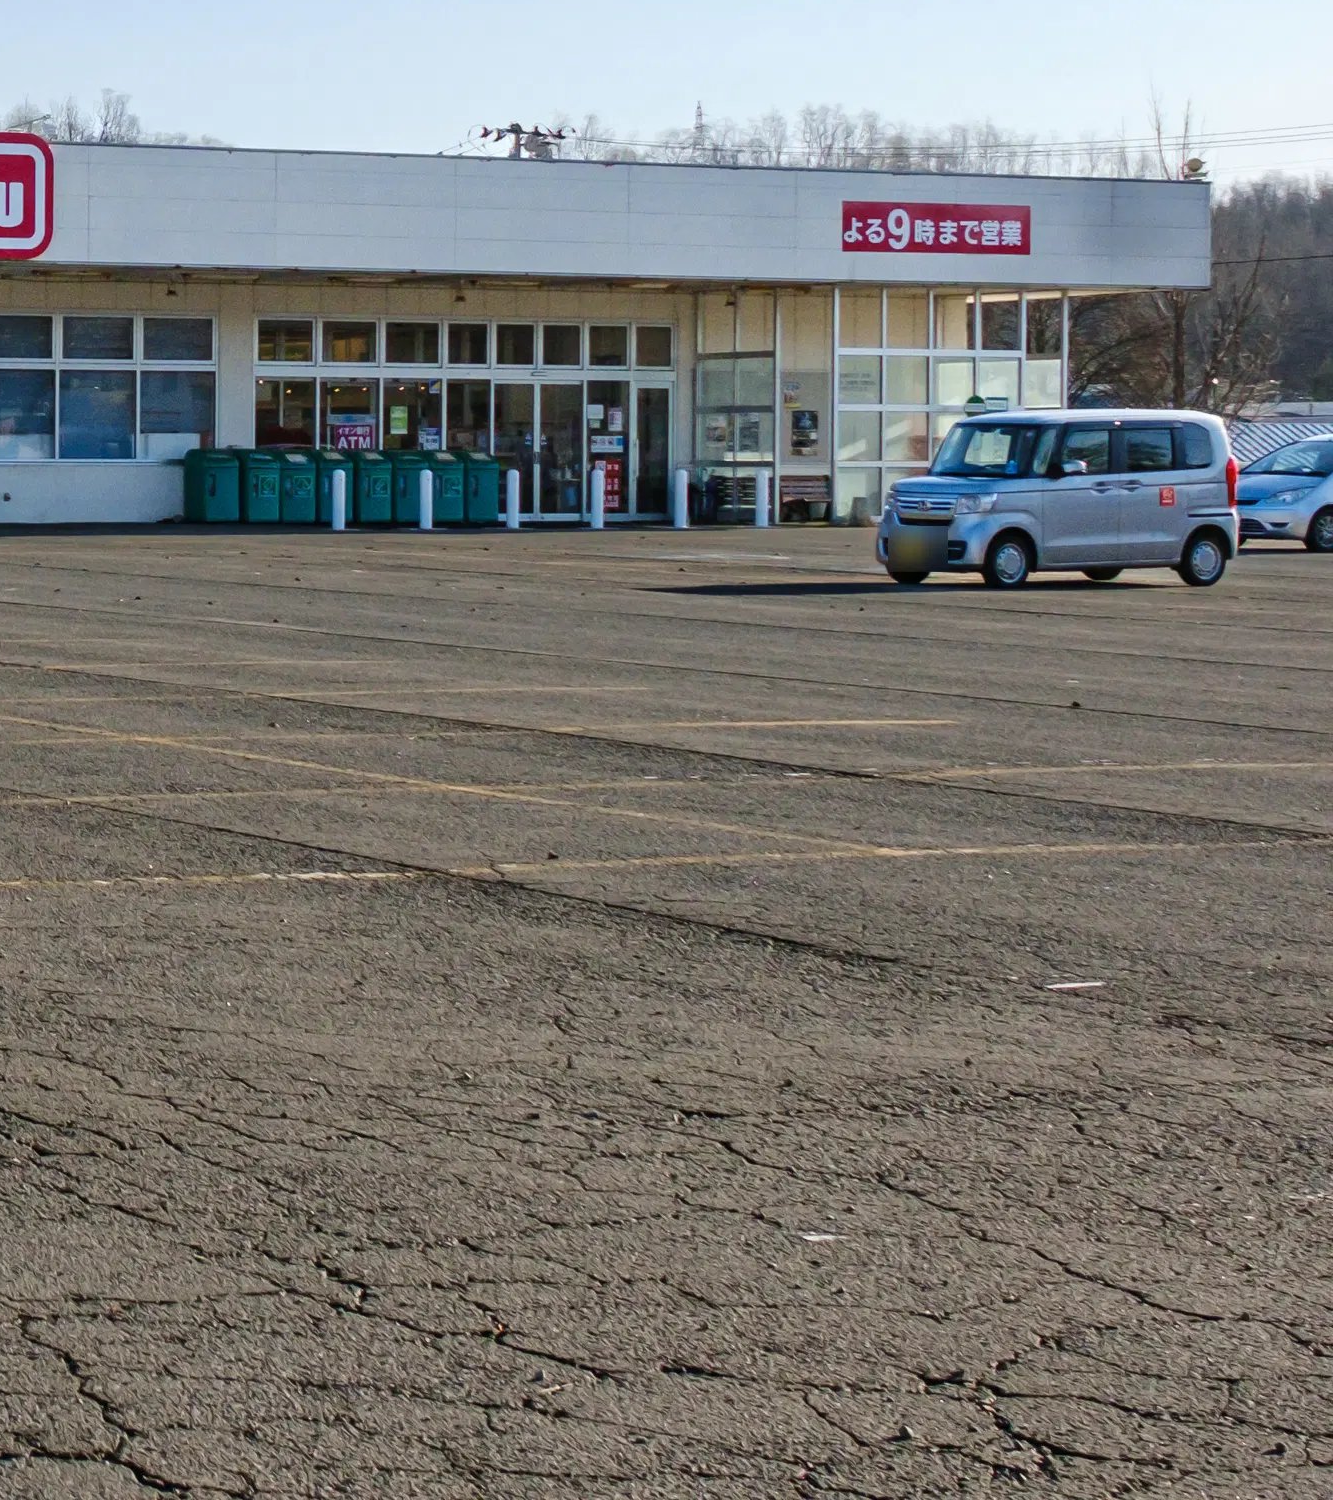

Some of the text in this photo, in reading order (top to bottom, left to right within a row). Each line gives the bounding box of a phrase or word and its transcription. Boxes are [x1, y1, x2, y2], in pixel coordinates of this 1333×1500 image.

[843, 208, 1022, 250] よる9時まで営業
[338, 436, 371, 449] ATM
